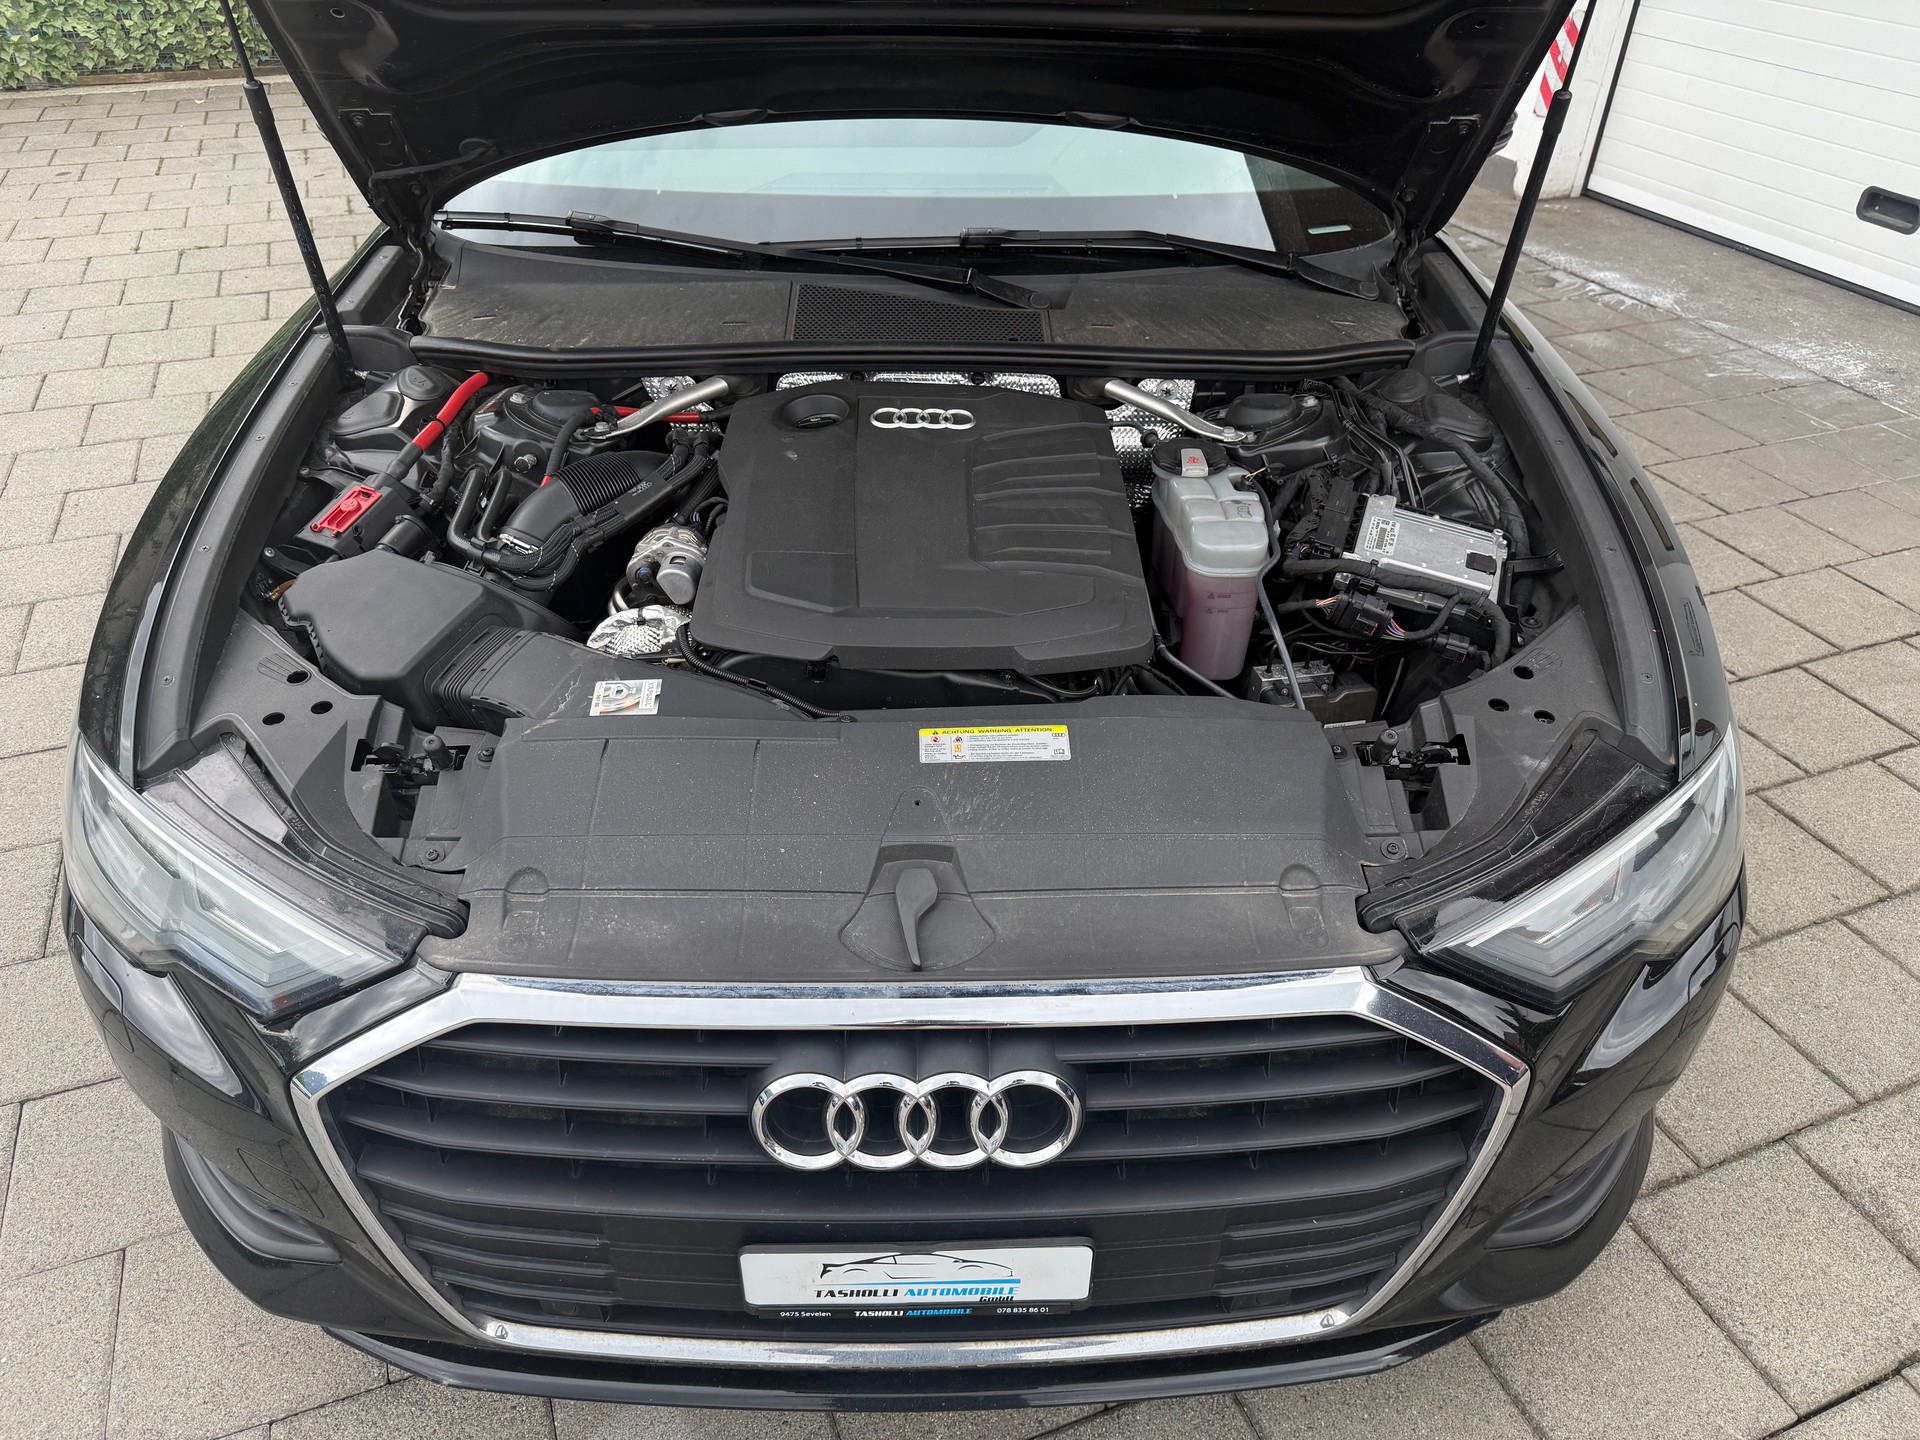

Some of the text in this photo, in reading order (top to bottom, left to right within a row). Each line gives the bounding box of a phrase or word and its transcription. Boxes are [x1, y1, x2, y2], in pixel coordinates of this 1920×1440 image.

[814, 1286, 1020, 1298] TASHOLLI AUTOMOBILE
[906, 1308, 973, 1316] AUTOMOBILE
